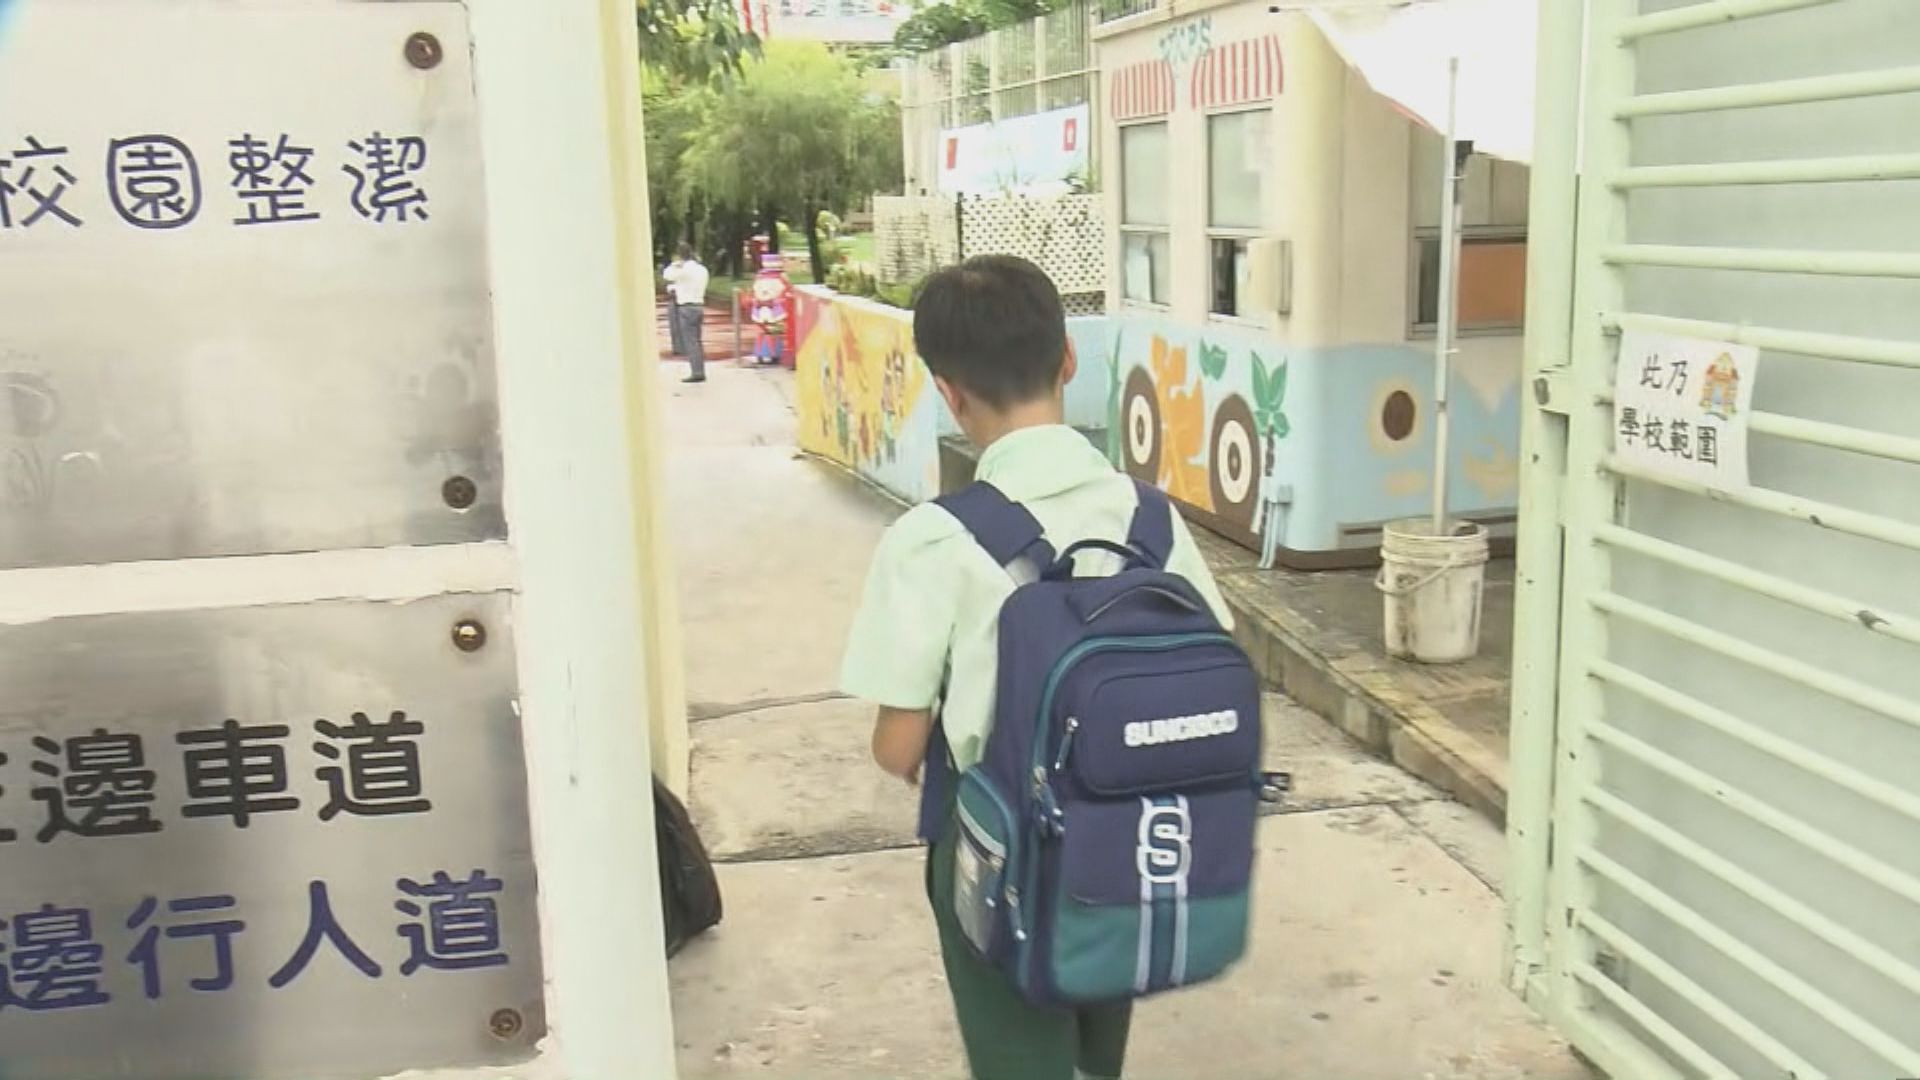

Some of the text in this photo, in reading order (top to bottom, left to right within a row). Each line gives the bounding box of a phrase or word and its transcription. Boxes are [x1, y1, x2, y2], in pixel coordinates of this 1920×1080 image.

[0, 131, 430, 229] 校園整潔
[1640, 352, 1689, 396] 此乃
[1619, 406, 1718, 468] 學校範圍
[0, 711, 432, 844] 邊車道
[0, 868, 510, 1011] 邊行人道
